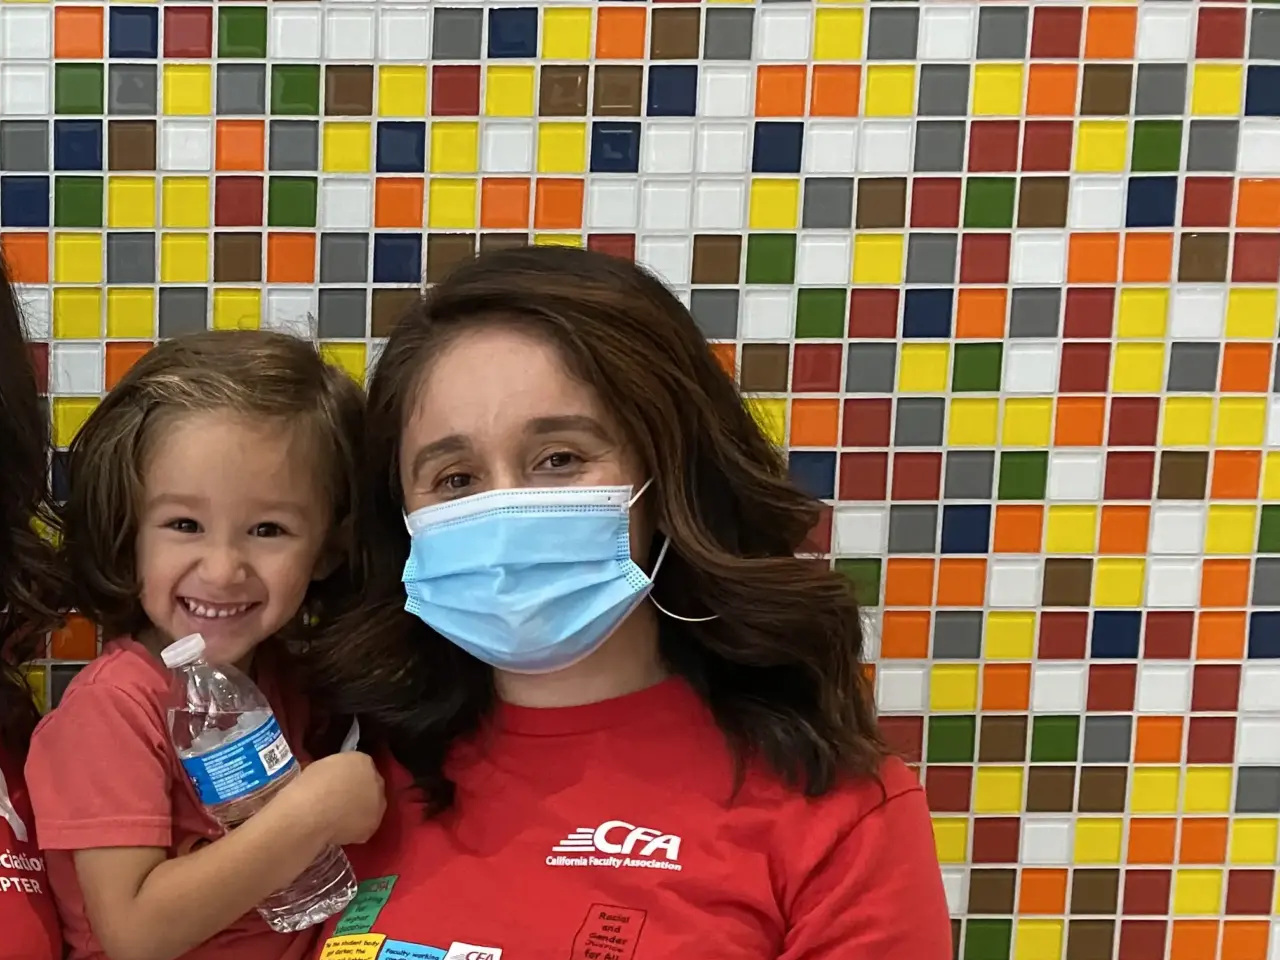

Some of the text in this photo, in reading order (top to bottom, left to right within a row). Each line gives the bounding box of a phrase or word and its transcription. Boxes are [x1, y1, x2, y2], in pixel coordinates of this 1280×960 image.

[593, 820, 682, 861] CFA
[546, 856, 682, 871] California Faculty Association
[599, 912, 630, 923] Racial
[602, 925, 621, 933] and
[588, 932, 628, 945] Gender
[385, 948, 410, 957] Faculty
[584, 949, 601, 959] for
